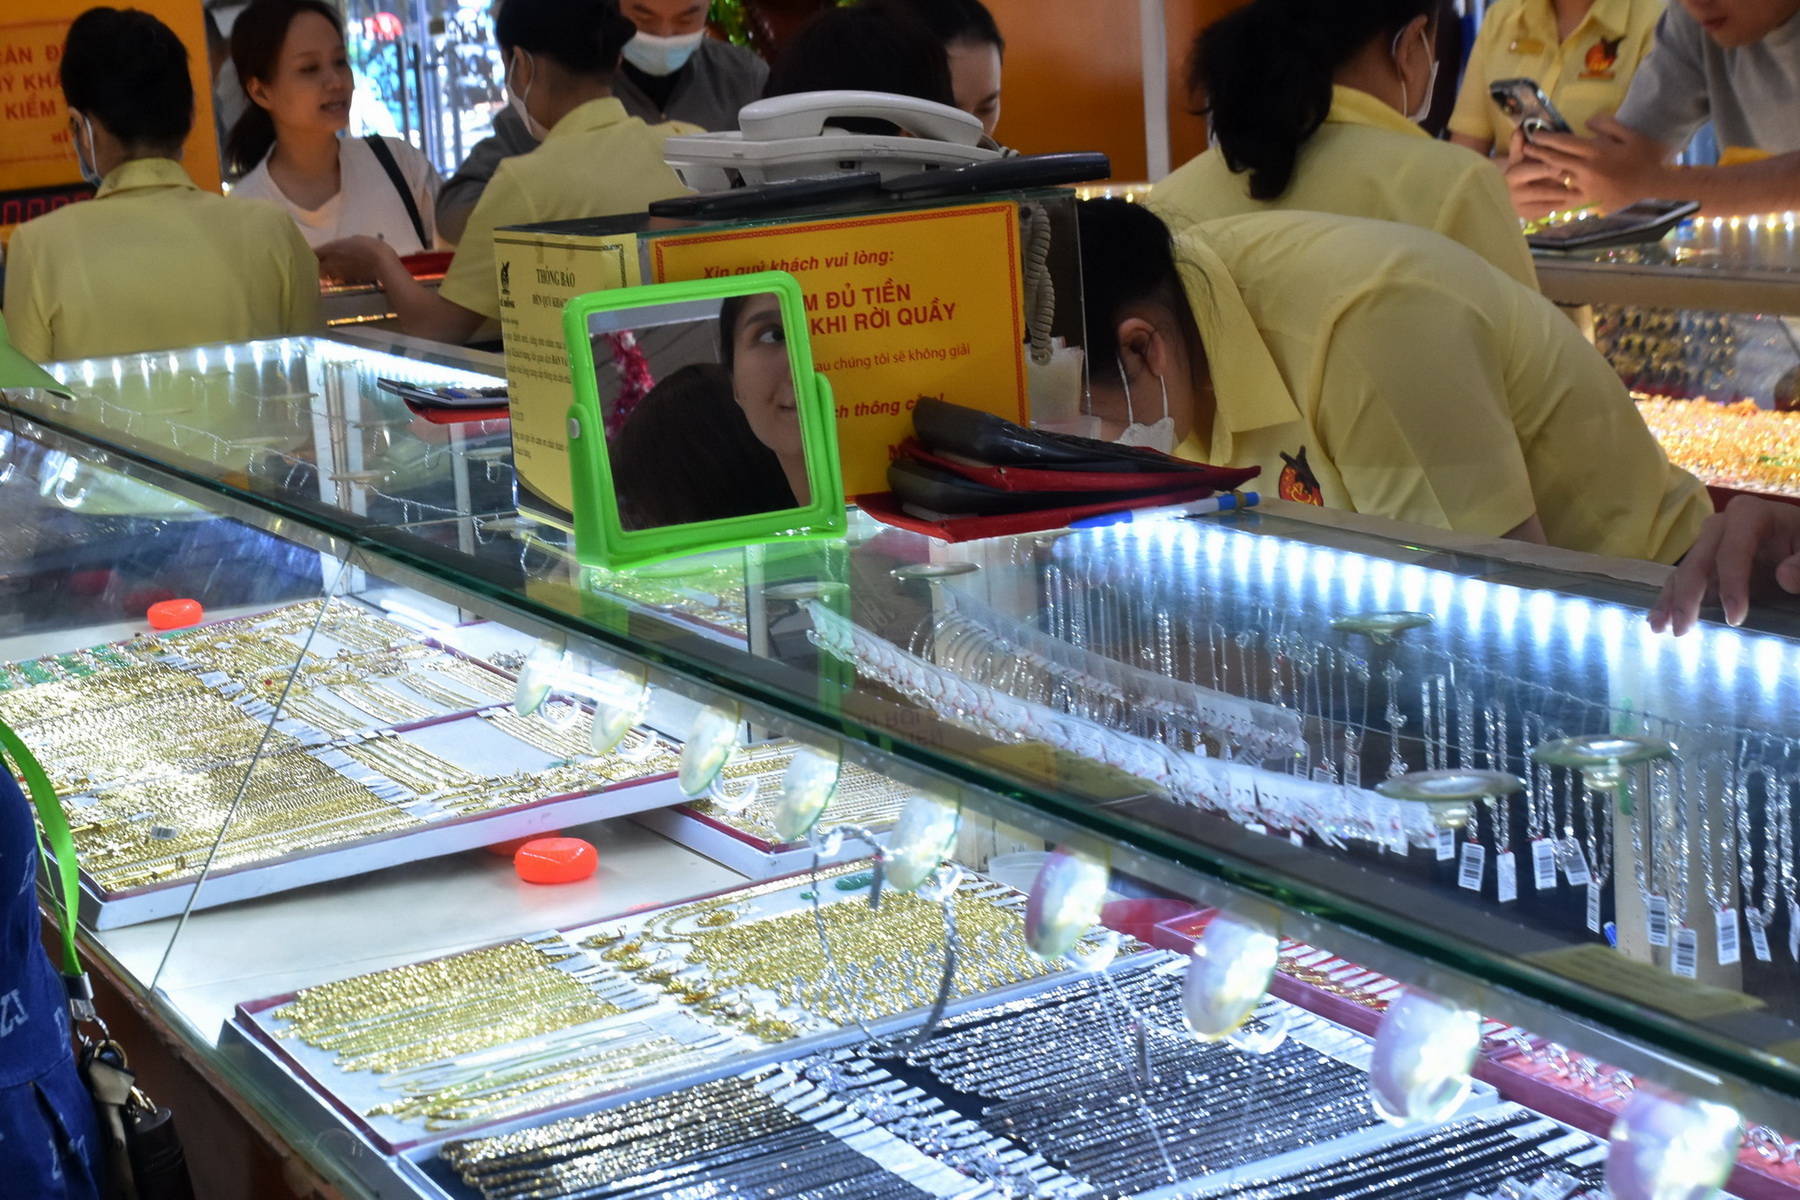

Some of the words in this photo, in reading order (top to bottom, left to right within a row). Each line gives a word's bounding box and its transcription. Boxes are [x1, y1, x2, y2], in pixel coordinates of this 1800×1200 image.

[770, 257, 819, 273] khách
[825, 252, 848, 268] vui
[826, 282, 855, 309] ĐỦ
[862, 278, 911, 305] TIỀN
[811, 315, 847, 336] KHI
[854, 306, 890, 331] RỜI
[897, 297, 956, 326] QUẦY
[874, 352, 890, 366] tôi
[908, 345, 947, 362] không
[855, 400, 900, 416] thông
